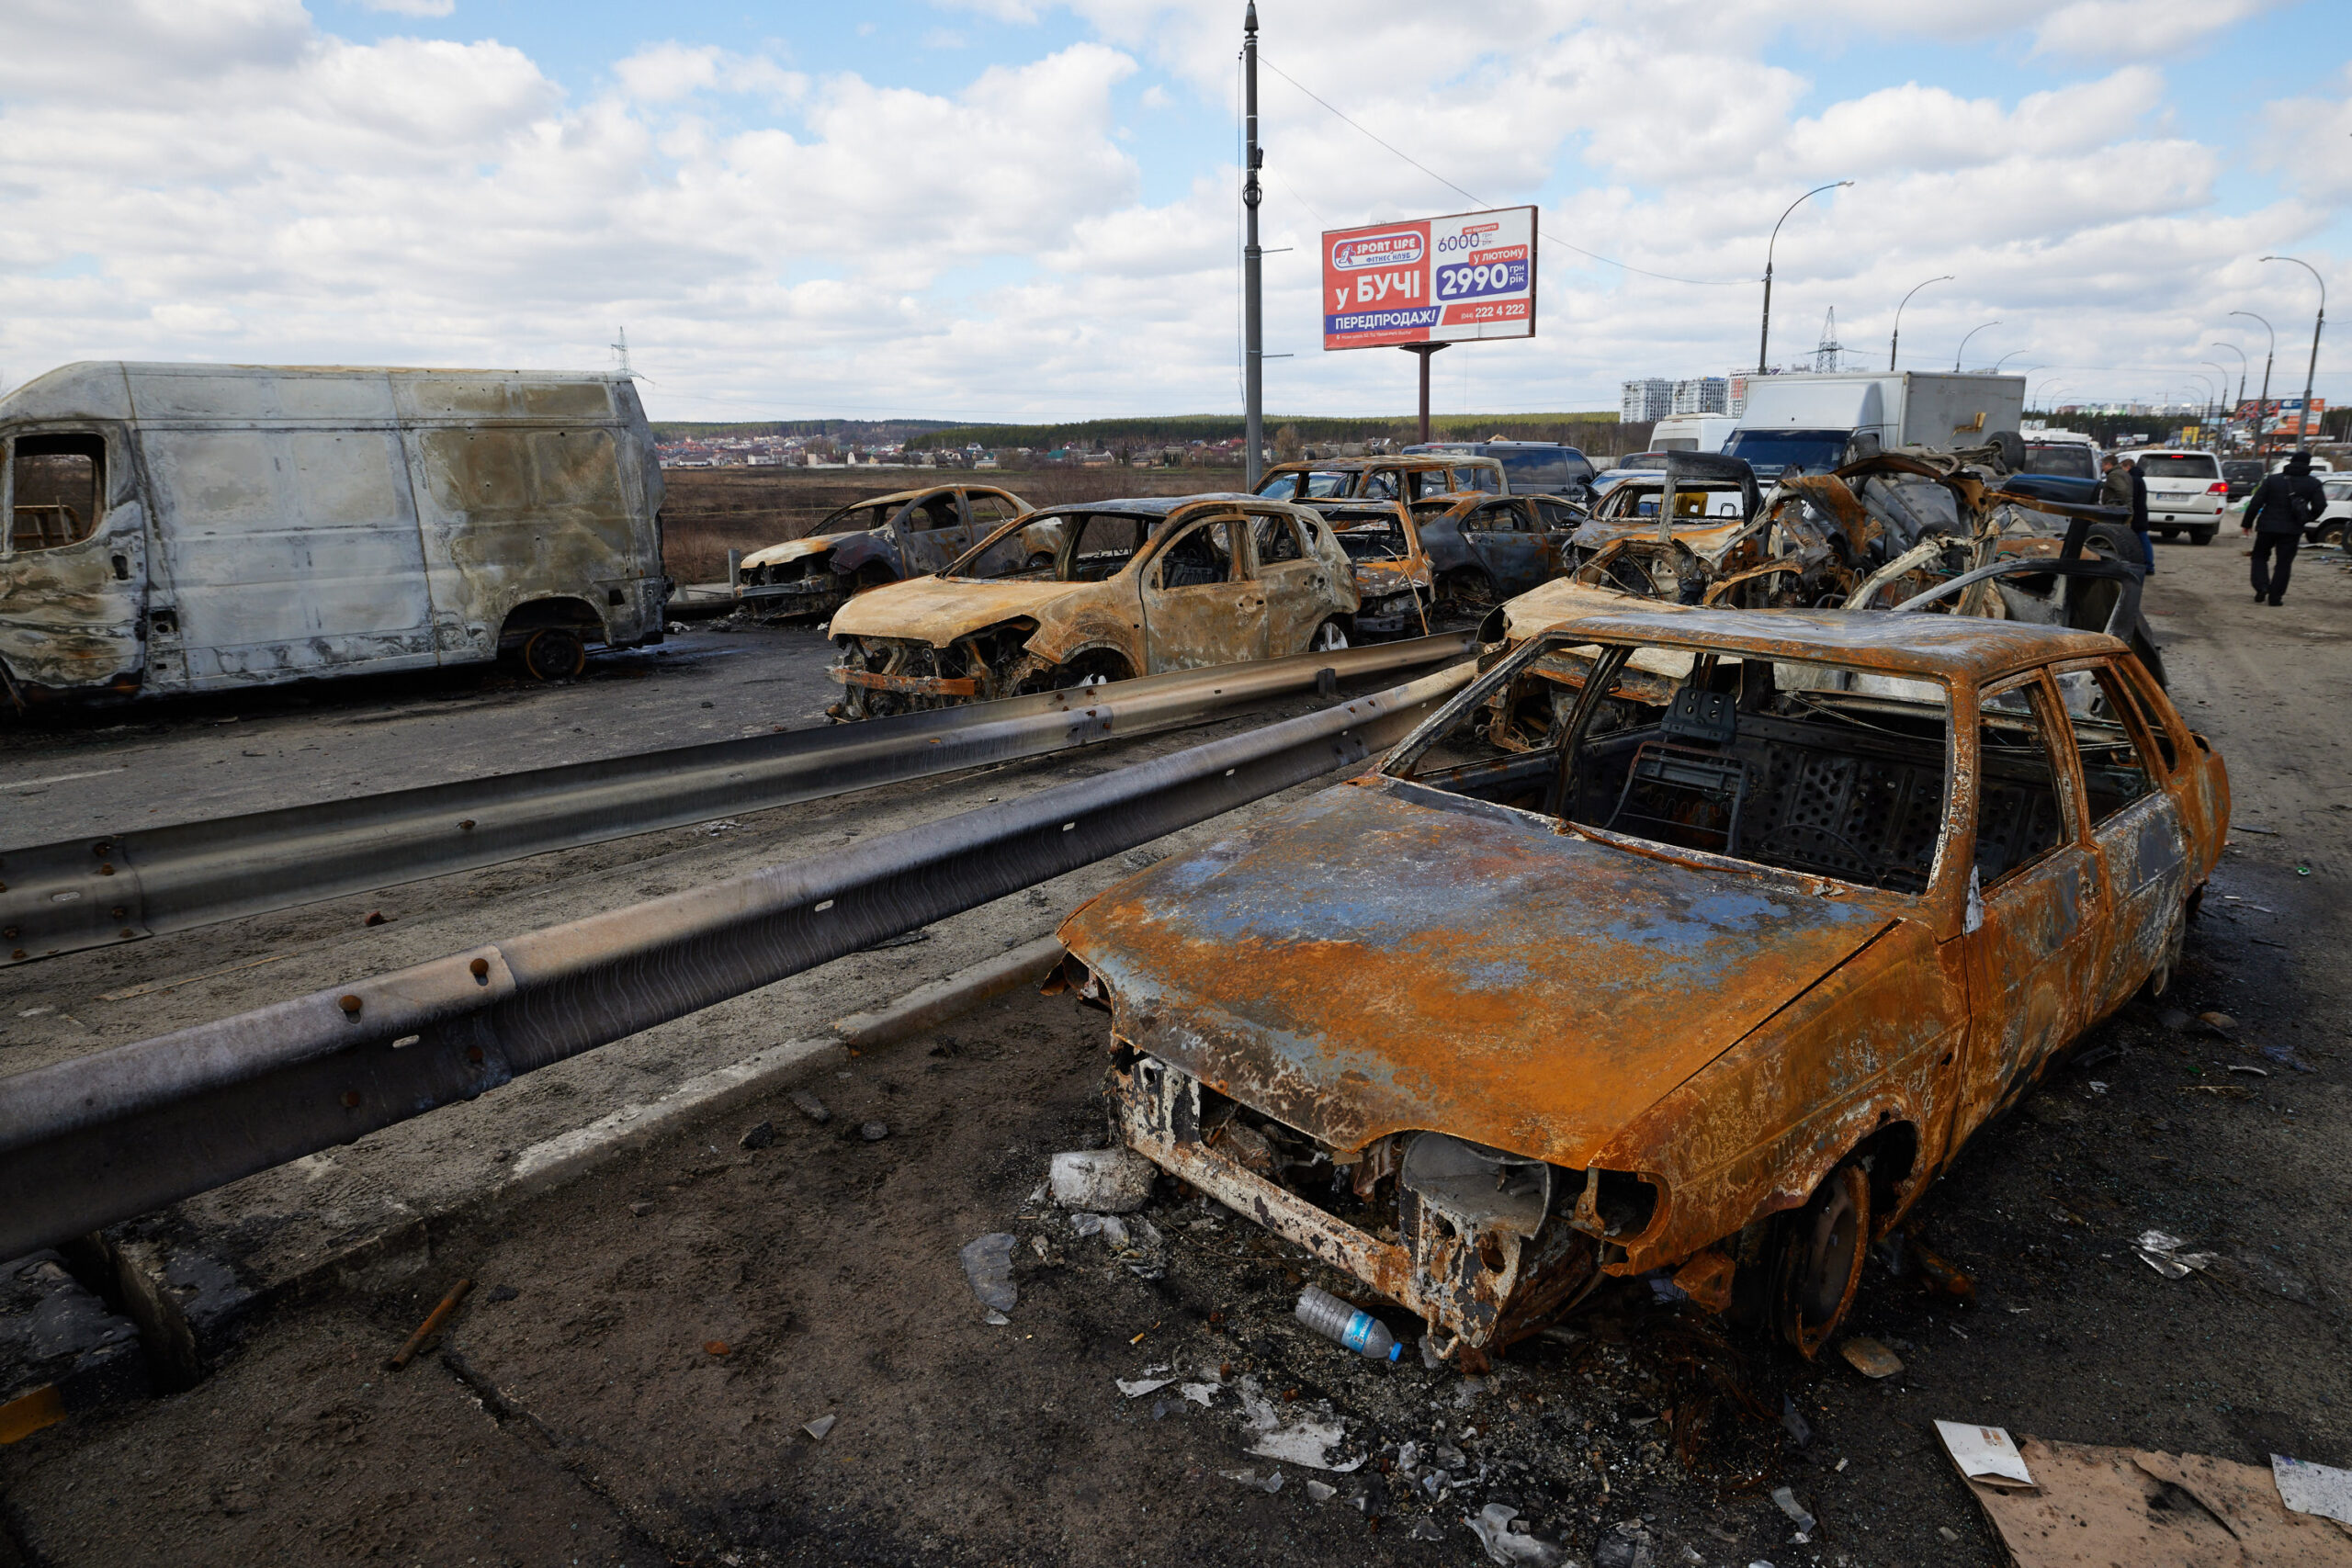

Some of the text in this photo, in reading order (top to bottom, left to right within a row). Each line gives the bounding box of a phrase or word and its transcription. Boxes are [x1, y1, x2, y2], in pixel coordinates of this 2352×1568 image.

[1357, 238, 1415, 254] SPORT LIFE
[1438, 233, 1479, 253] 6000
[1366, 254, 1391, 263] ФІТНЕС
[1482, 247, 1525, 262] лютому
[1510, 264, 1525, 273] грн
[1442, 264, 1508, 296] 2990
[1510, 275, 1524, 286] рік
[1335, 270, 1419, 310] у БУЧІ
[1476, 306, 1494, 318] 222
[1496, 305, 1503, 316] 4
[1505, 303, 1525, 315] 222
[1335, 310, 1436, 330] ПЕРЕДПРОДАЖ!
